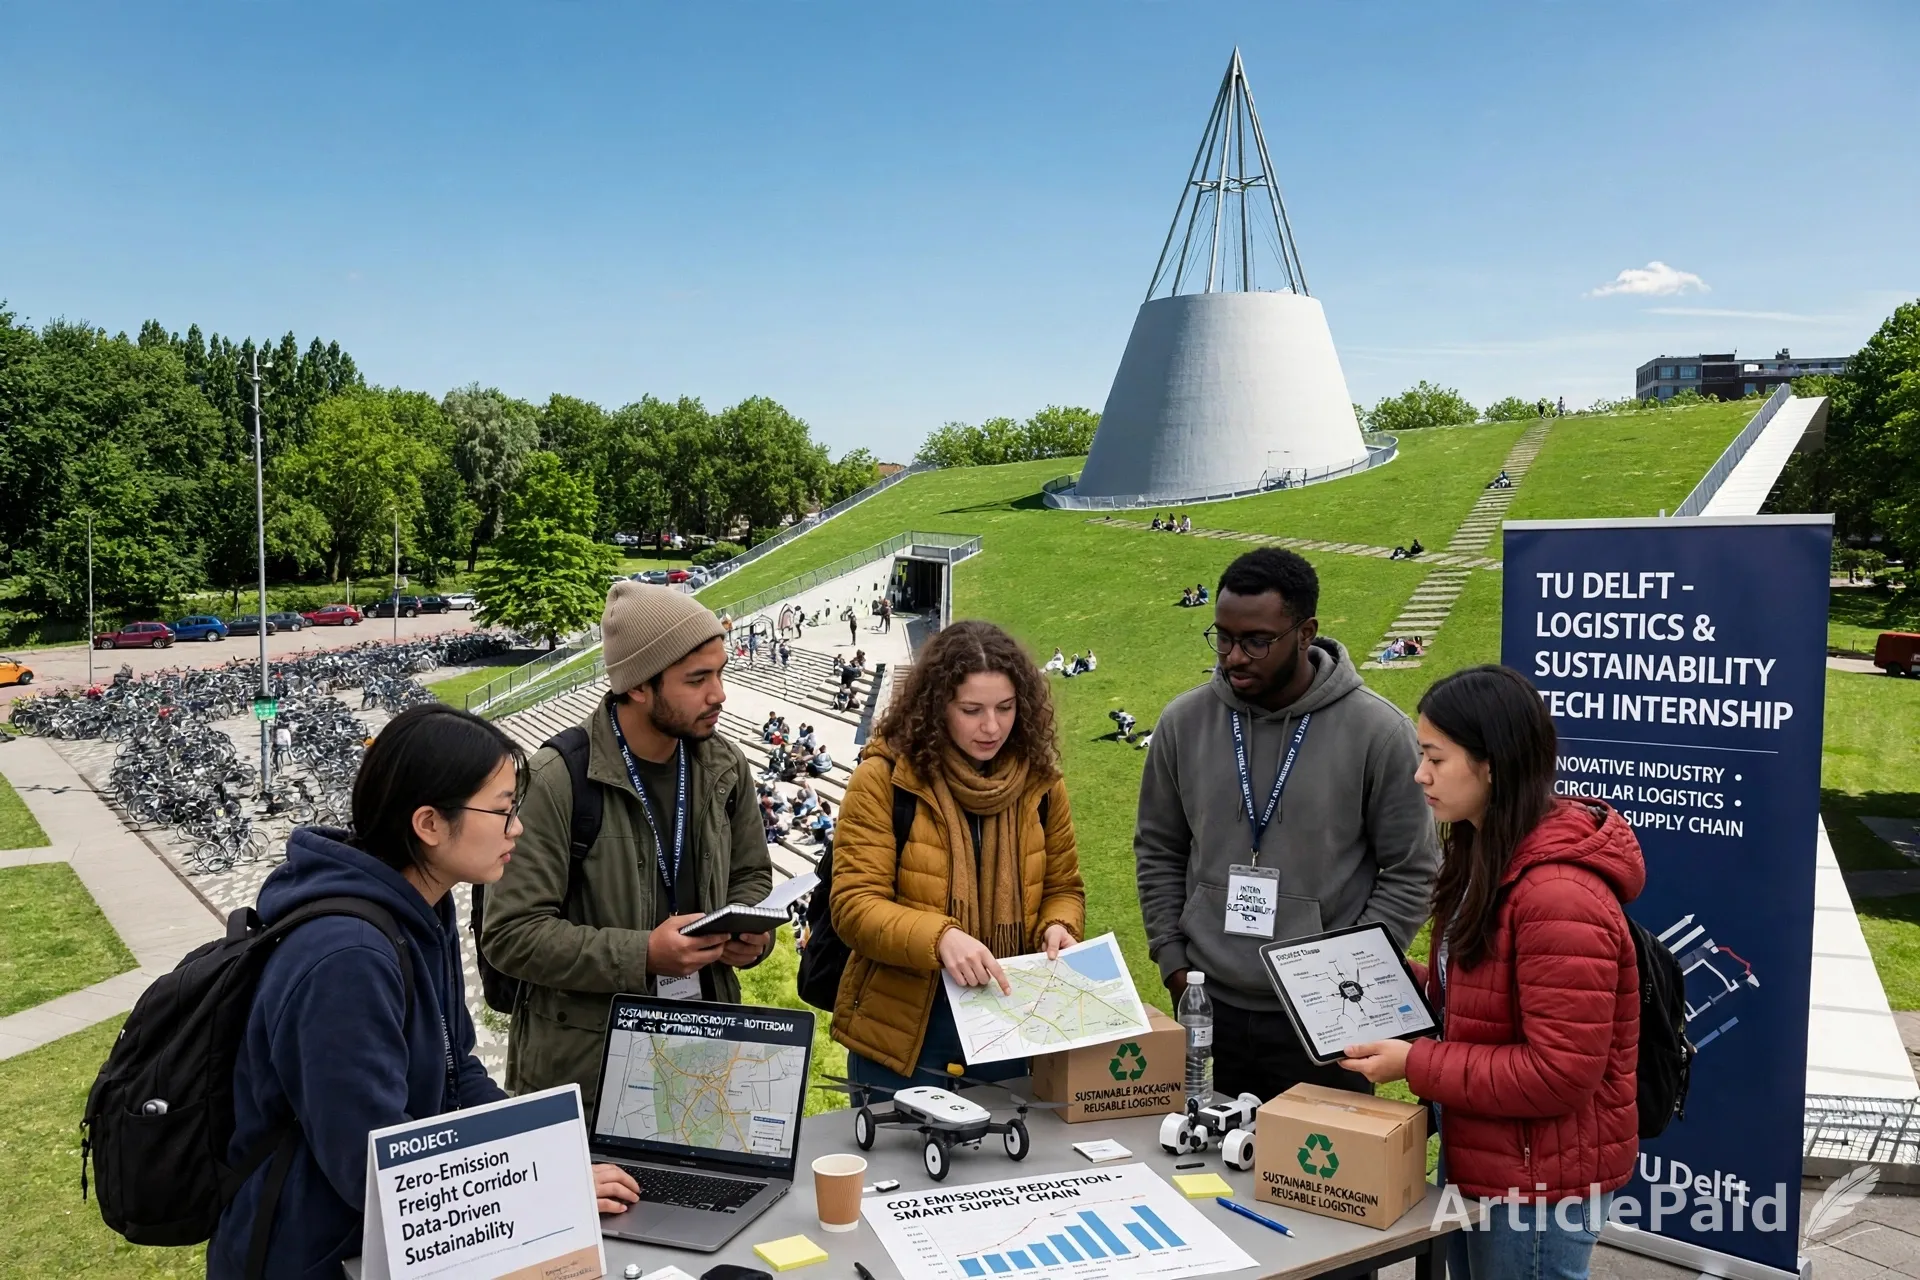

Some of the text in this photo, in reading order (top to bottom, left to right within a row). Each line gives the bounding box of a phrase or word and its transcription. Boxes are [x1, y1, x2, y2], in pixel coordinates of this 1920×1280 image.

[1536, 572, 1574, 598] TU
[1583, 572, 1675, 600] DELFT
[1536, 611, 1716, 642] LOGISTICS &
[1534, 650, 1777, 686] SUSTAINABILITY
[1612, 693, 1794, 730] INTERNSHIP
[1639, 761, 1725, 784] INDUSTRY
[1554, 780, 1724, 810] CIRCULAR LOGISTICS
[1623, 809, 1744, 838] SUPPLY CHAIN
[1075, 1086, 1131, 1102] SUSTAINABLE
[1084, 1095, 1171, 1113] REUSABLE LOGISTICS
[388, 1129, 459, 1159] PROJECT:
[394, 1150, 510, 1193] Zero-Emission
[1263, 1171, 1322, 1194] SUSTAINABLE
[1637, 1152, 1750, 1207] U Delft
[398, 1185, 460, 1217] Freight
[463, 1167, 528, 1198] Corridor
[886, 1198, 922, 1211] CO2
[924, 1187, 1014, 1207] EMISSIONS
[1016, 1173, 1111, 1194] REDUCTION
[893, 1188, 1081, 1222] SMART SUPPLY CHAIN
[1271, 1186, 1366, 1217] REUSABLE LOGISTICS
[402, 1200, 501, 1241] Data-Driven
[405, 1219, 515, 1266] Sustainability
